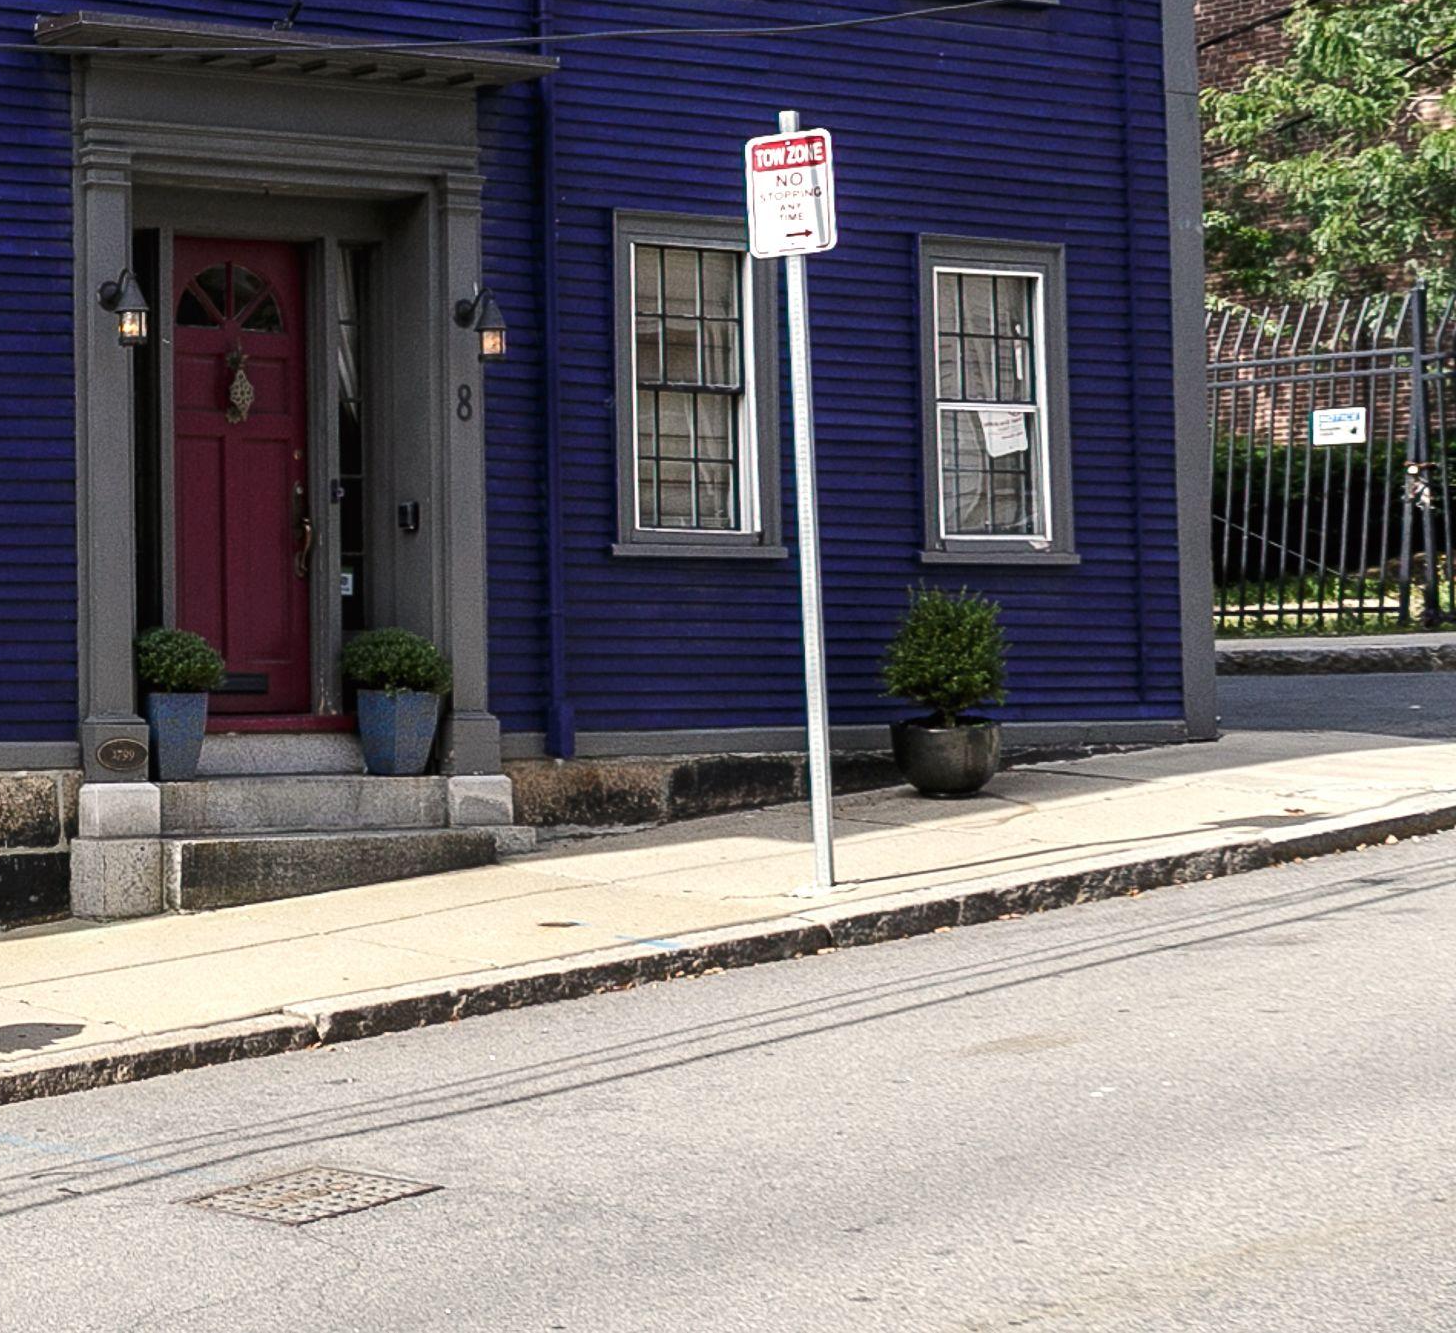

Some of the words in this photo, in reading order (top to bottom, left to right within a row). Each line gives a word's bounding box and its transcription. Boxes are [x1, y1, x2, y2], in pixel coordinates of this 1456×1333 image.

[755, 147, 785, 168] TOW
[786, 142, 823, 164] ZONE
[776, 172, 803, 187] NO
[760, 186, 822, 204] STOPPING
[780, 203, 801, 211] ANY
[779, 212, 804, 221] TIME
[456, 384, 473, 422] 8
